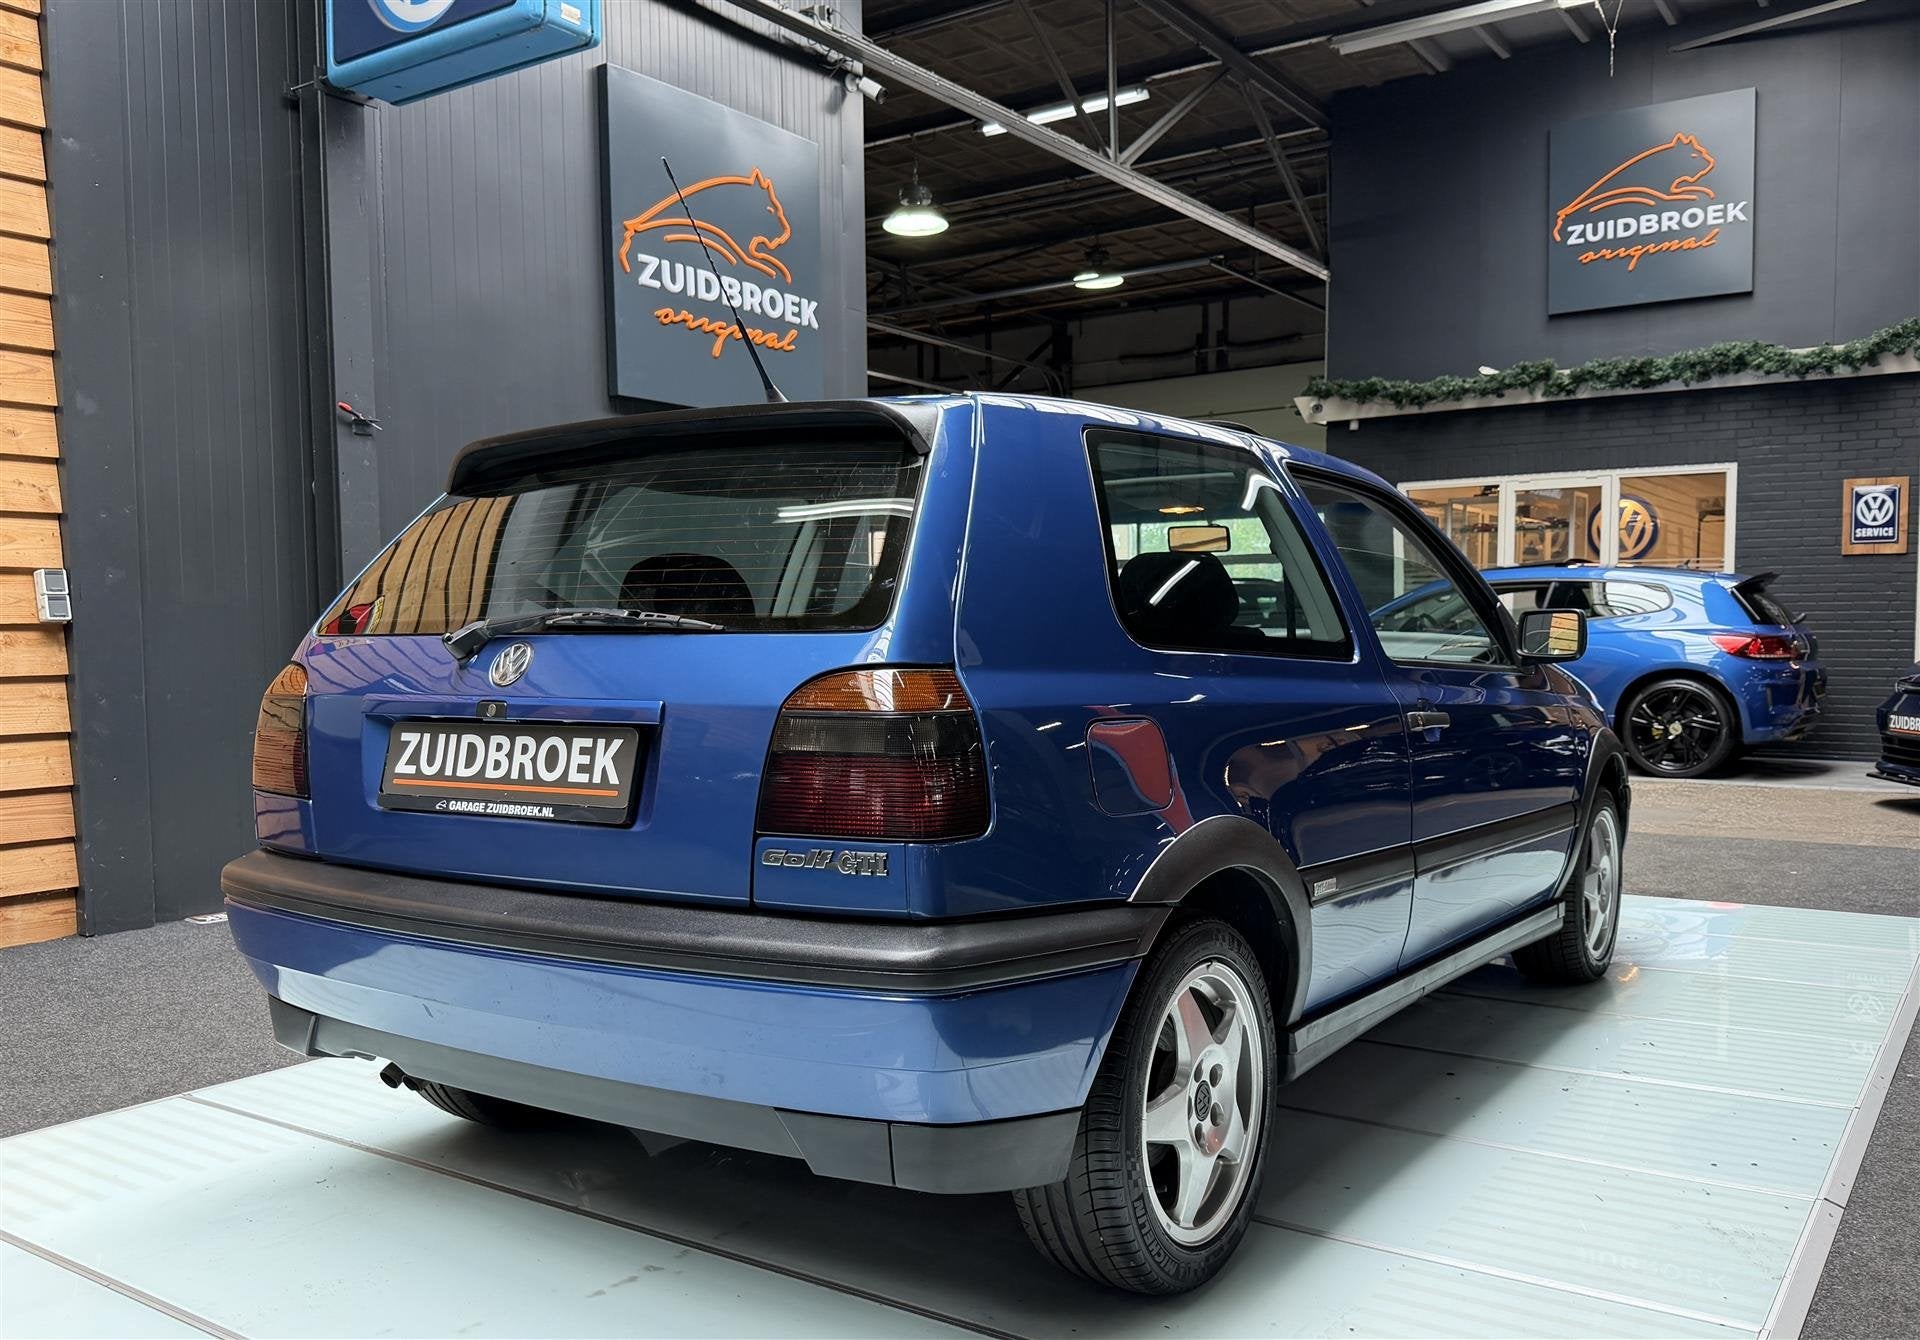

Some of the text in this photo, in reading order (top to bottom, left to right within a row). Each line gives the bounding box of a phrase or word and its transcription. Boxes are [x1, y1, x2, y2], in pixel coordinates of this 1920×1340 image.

[1566, 200, 1749, 246] ZUIDBROEK
[1577, 227, 1722, 273] original
[637, 253, 820, 330] ZUIDBROEK
[654, 307, 799, 359] original
[1855, 527, 1894, 538] SERVICE
[394, 732, 624, 785] ZUIDBROEK
[449, 800, 554, 818] GARAGE ZUIDBROEK.NL
[762, 849, 887, 876] Golf GTI
